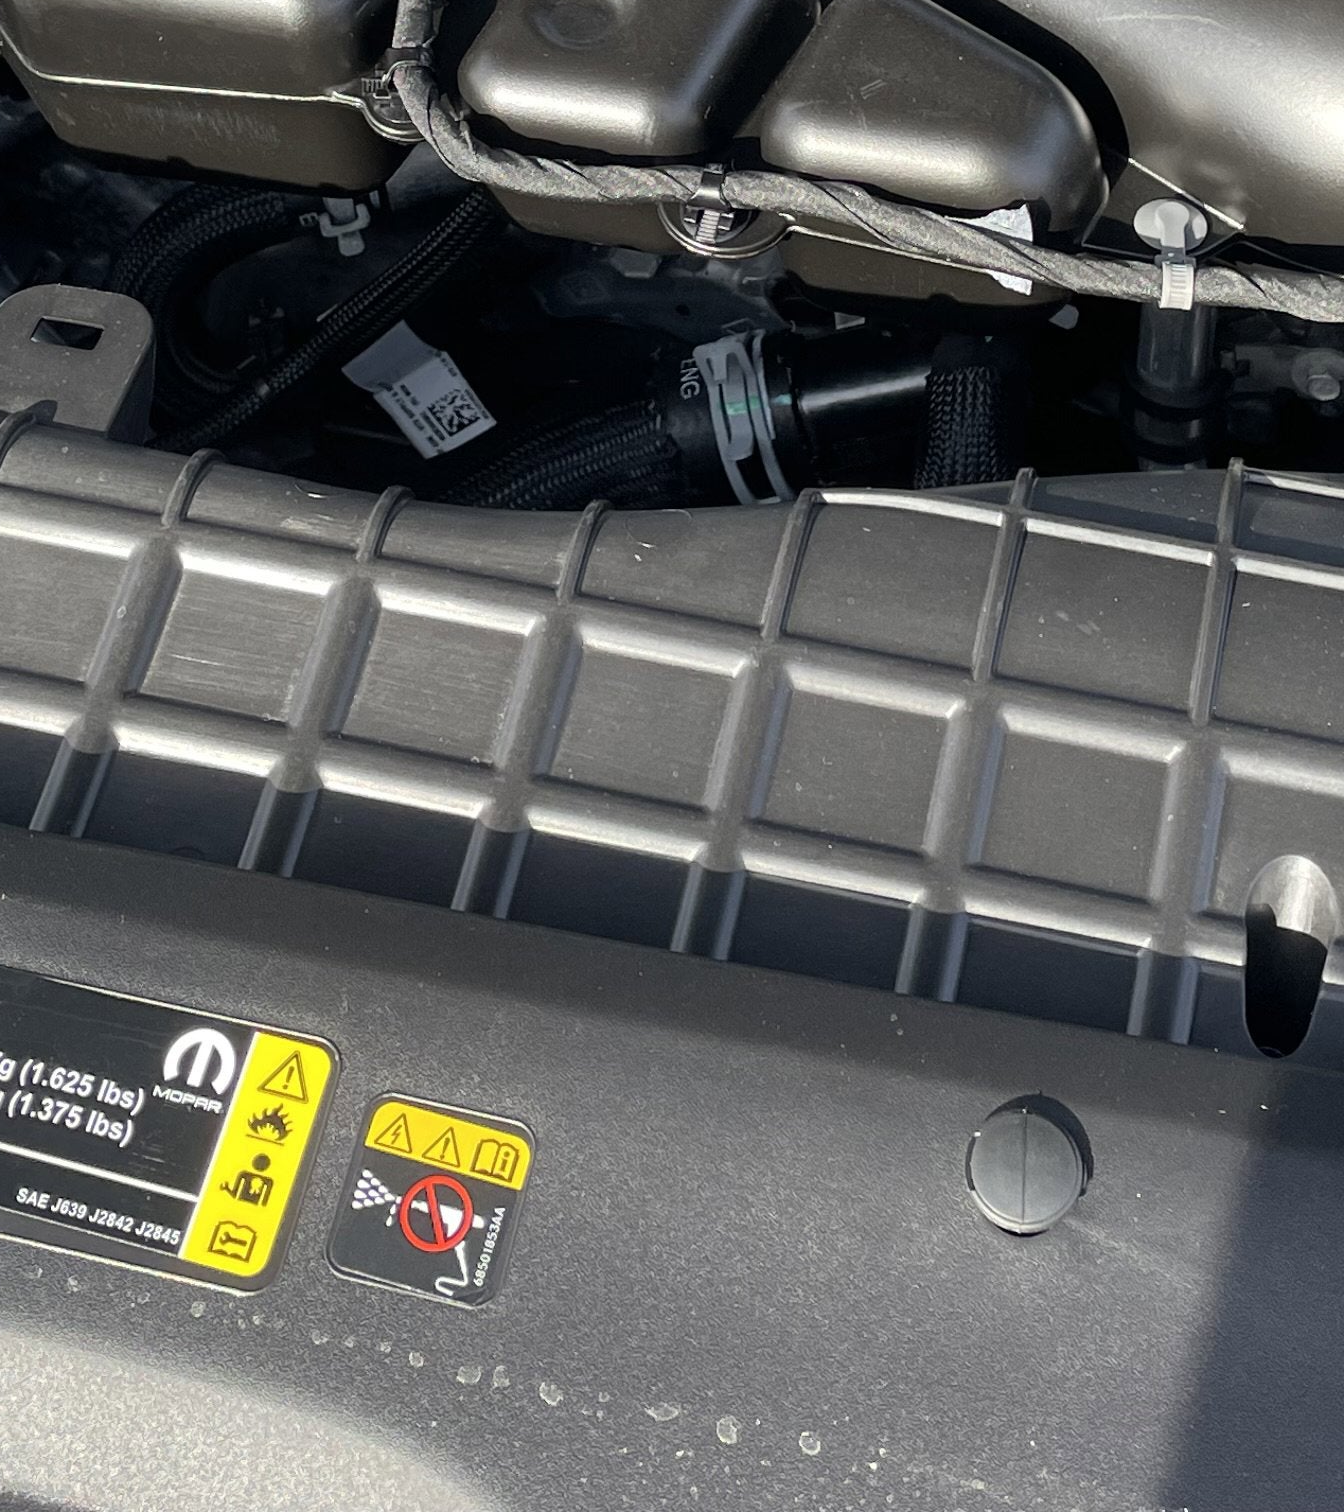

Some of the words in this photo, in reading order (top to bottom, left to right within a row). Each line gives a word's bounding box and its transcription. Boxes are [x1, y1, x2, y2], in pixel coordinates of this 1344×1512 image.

[20, 1058, 95, 1098] (1.625
[97, 1078, 145, 1116] lbs)
[153, 1085, 223, 1114] MOPAR
[8, 1090, 84, 1129] (1.375
[86, 1111, 134, 1148] lbs)
[16, 1187, 50, 1211] SAE
[51, 1197, 87, 1219] J639
[89, 1206, 133, 1232] J2842
[135, 1219, 181, 1245] J2845
[473, 1207, 506, 1287] 68501853AA
